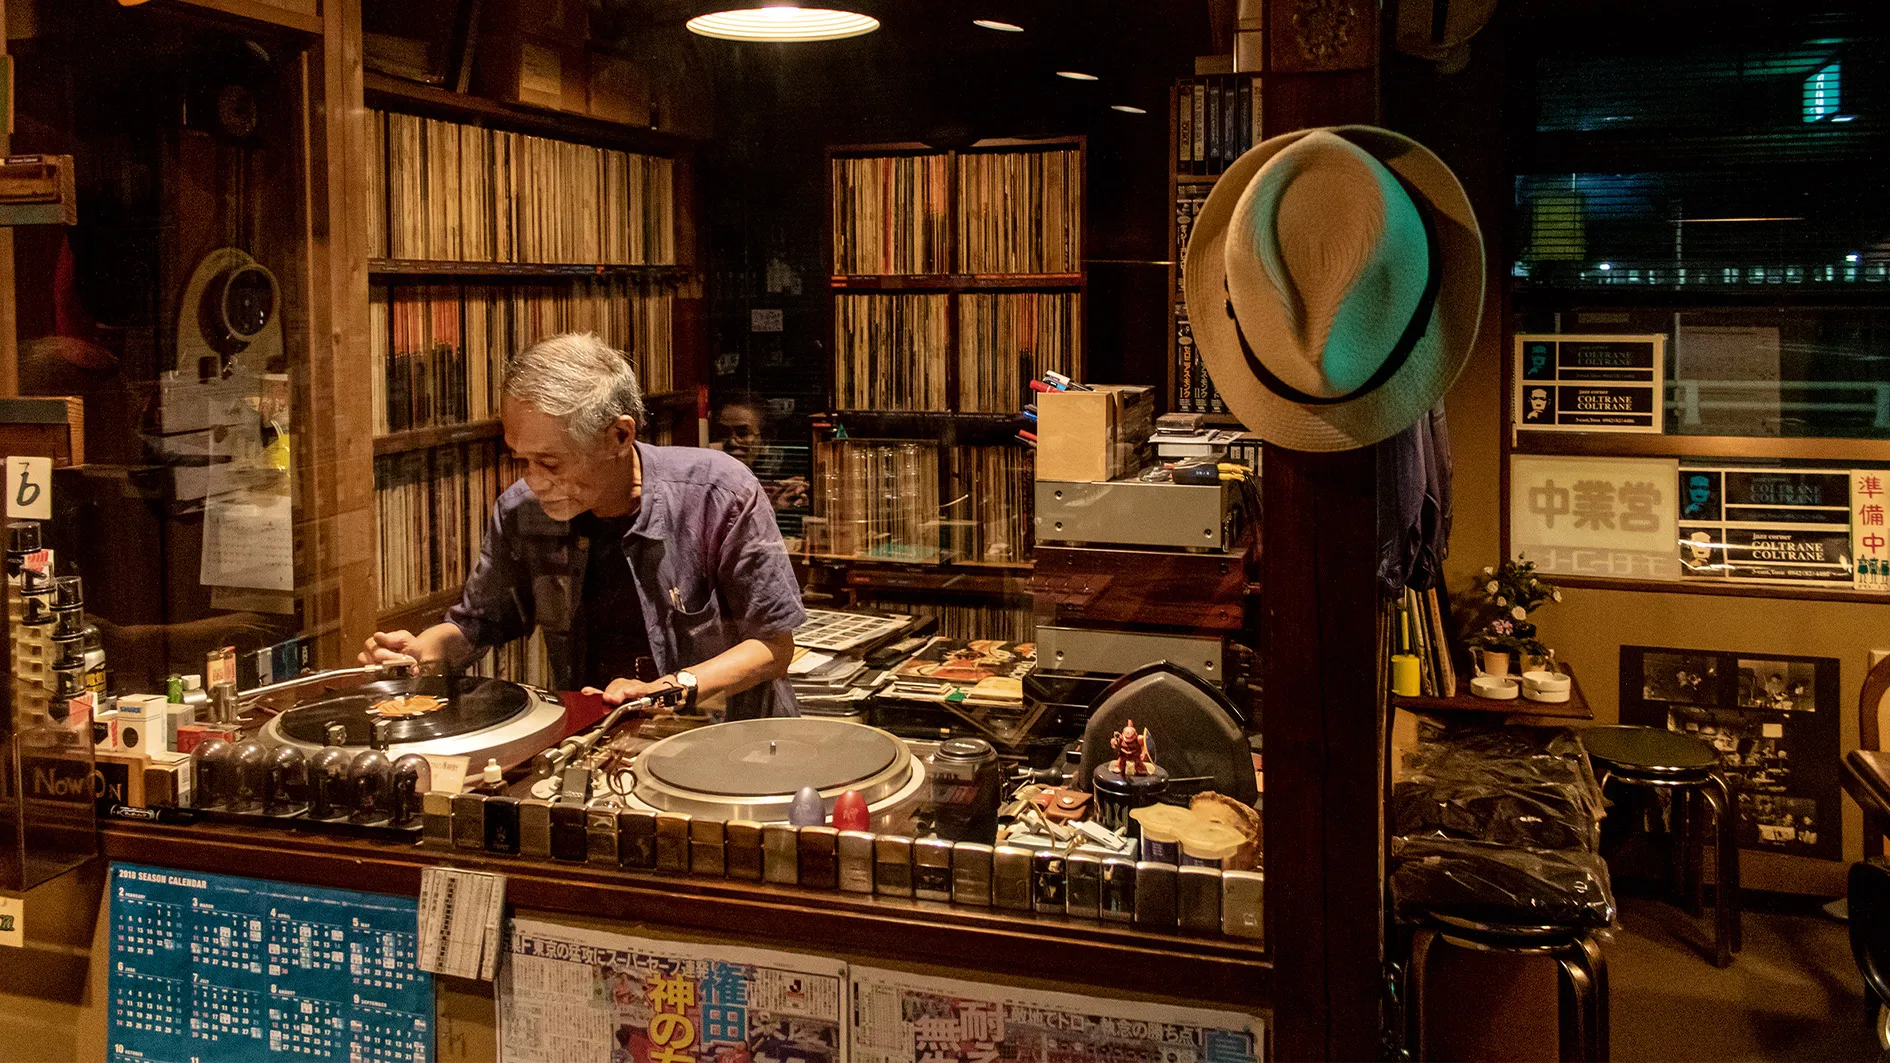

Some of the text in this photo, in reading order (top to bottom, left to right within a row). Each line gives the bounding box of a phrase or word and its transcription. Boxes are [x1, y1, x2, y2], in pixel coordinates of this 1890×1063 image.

[1577, 395, 1632, 403] COLTRANE
[1577, 403, 1632, 411] COLTRANE
[1857, 475, 1885, 554] 準備中
[1751, 541, 1823, 552] COLTRANE
[1752, 550, 1825, 561] COLTRANE
[119, 869, 207, 889] 2018 SEASON CALENDAR
[118, 887, 124, 897] 2
[192, 897, 198, 907] 3
[270, 908, 276, 917] 4
[352, 917, 359, 927] 5
[117, 961, 124, 971] 6
[192, 973, 199, 982] 7
[270, 984, 277, 993] 8
[353, 994, 360, 1004] 9
[114, 1043, 124, 1054] 10
